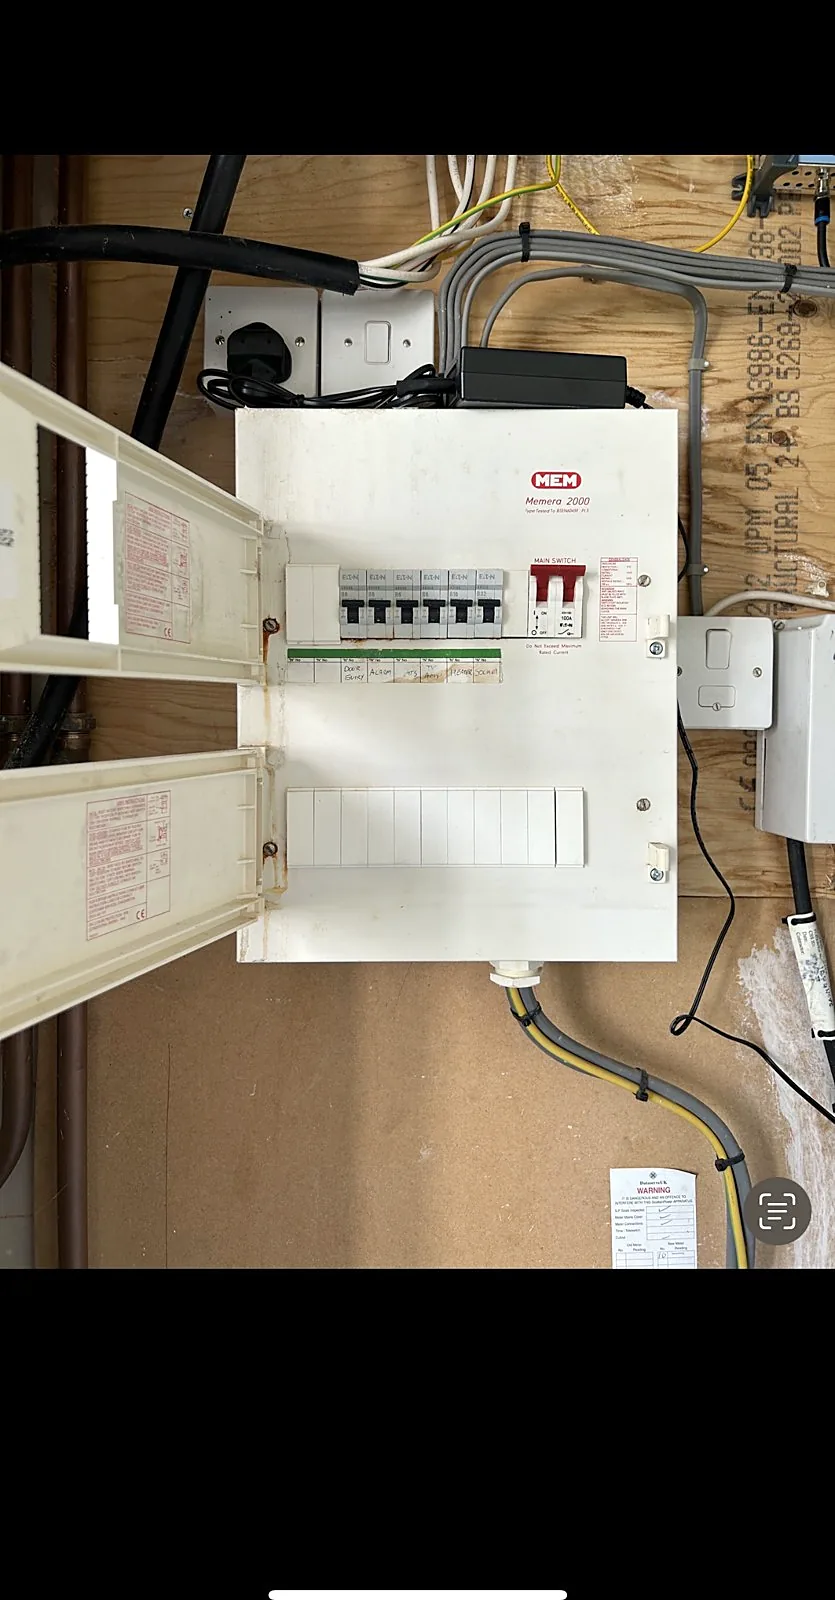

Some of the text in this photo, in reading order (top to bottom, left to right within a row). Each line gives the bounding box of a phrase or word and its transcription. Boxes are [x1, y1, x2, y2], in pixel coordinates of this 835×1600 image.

[775, 390, 801, 418] BS
[535, 473, 577, 487] MEM
[525, 497, 590, 505] Memera 2000
[745, 509, 772, 554] UPM
[637, 1186, 671, 1194] WARNING
